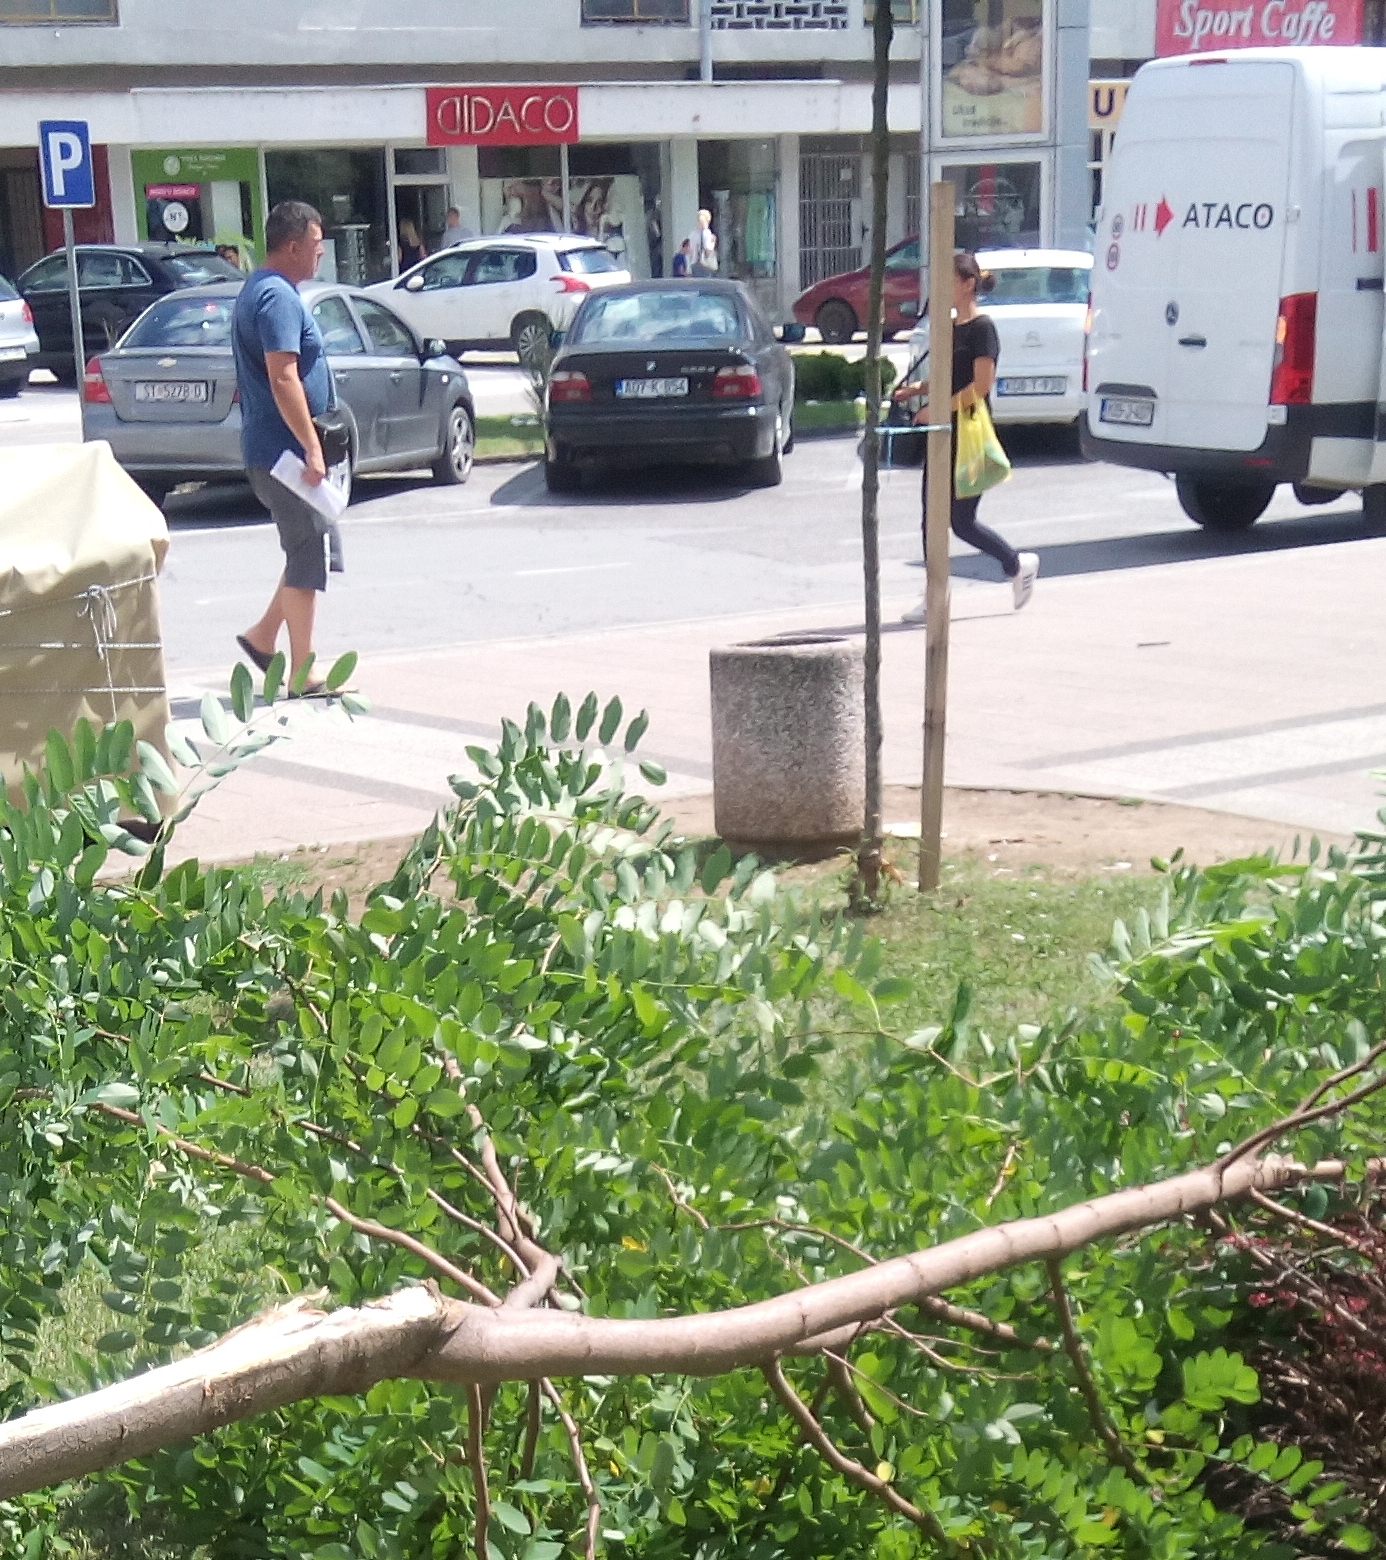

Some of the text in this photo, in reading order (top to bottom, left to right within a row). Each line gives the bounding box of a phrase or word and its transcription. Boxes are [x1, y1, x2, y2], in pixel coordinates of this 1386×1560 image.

[1174, 0, 1336, 50] Sport Caffe
[437, 94, 574, 135] DIDACO
[48, 131, 83, 197] P
[1182, 202, 1274, 230] ATACO
